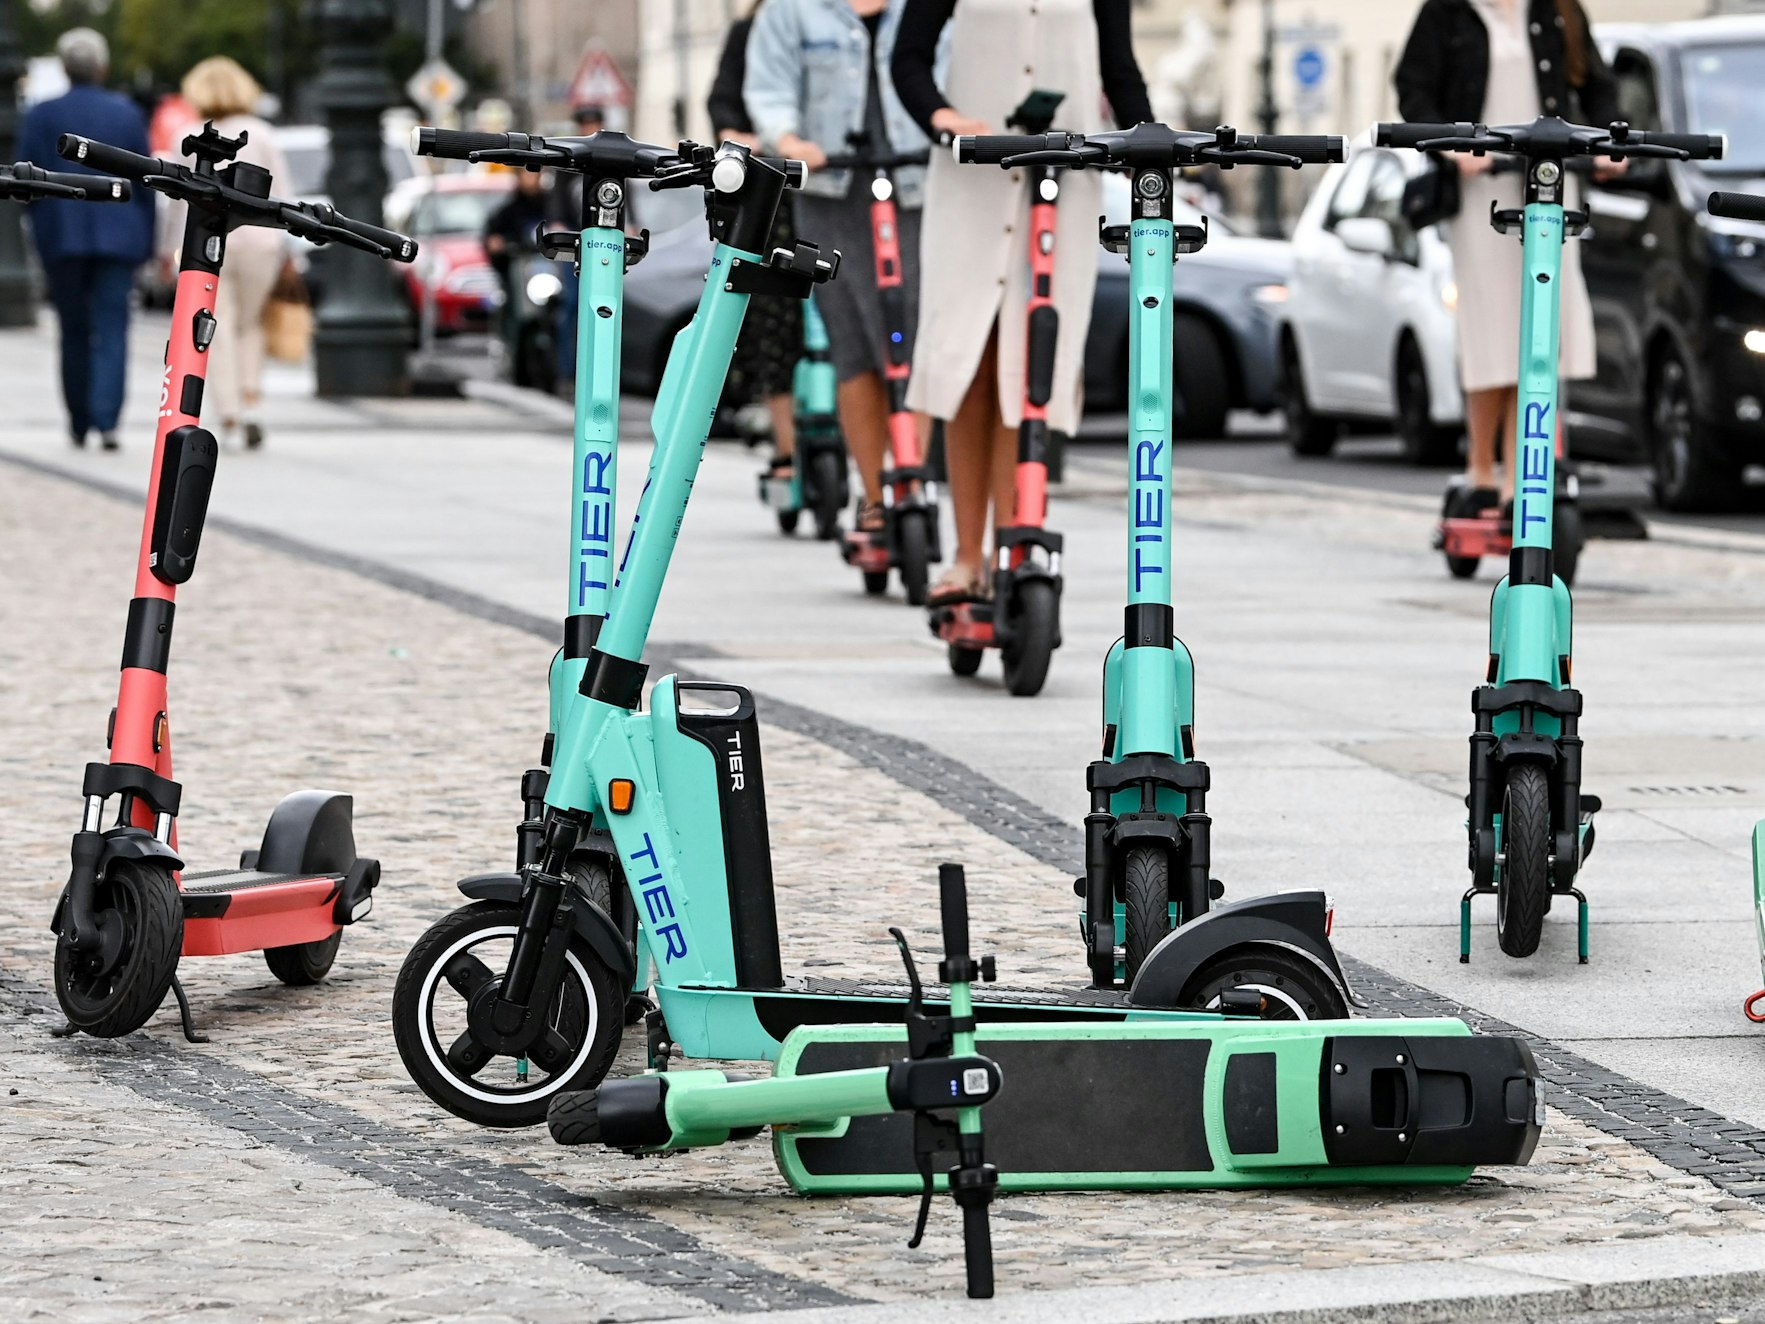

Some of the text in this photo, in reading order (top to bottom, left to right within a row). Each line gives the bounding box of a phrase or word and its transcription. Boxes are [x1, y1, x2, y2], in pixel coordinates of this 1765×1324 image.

[587, 240, 622, 252] tier.app
[1134, 228, 1169, 238] tier.app
[579, 452, 612, 606] TIER
[1135, 440, 1163, 593] TIER
[1521, 401, 1550, 539] TIER
[727, 731, 745, 792] TIER
[630, 832, 688, 965] TIER
